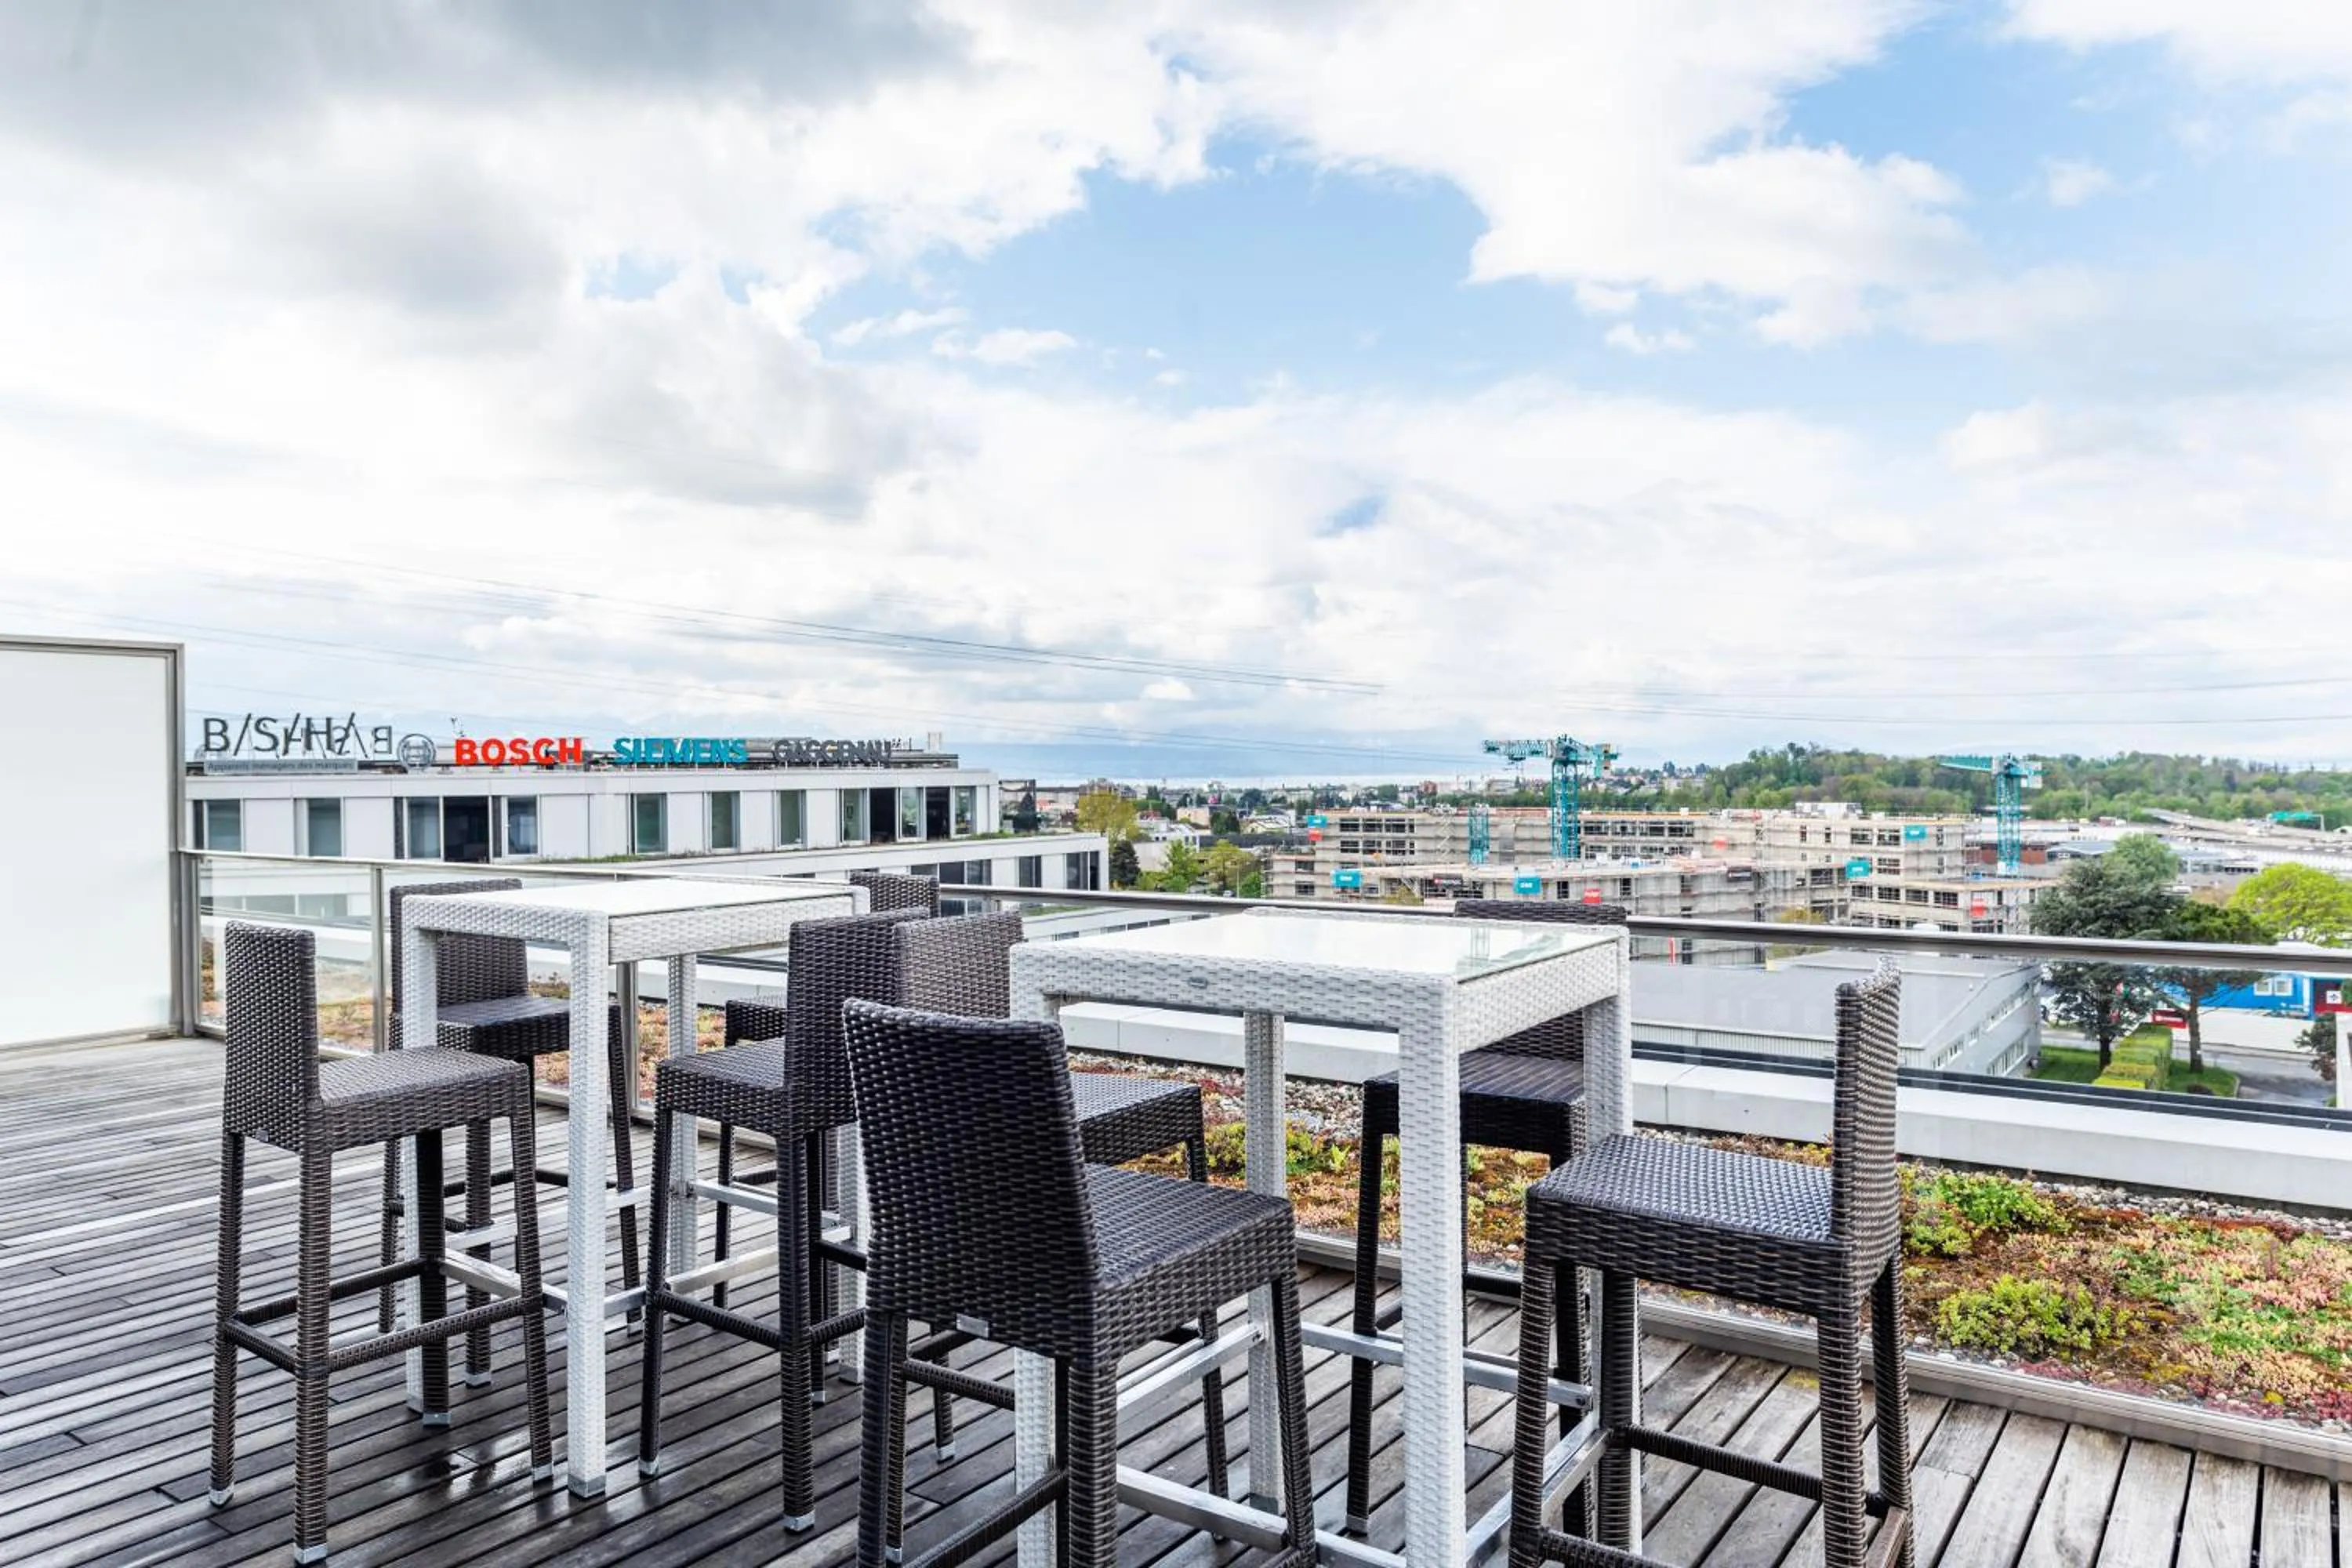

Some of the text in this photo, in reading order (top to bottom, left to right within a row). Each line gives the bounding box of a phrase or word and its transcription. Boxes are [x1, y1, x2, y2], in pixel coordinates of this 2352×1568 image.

[455, 738, 583, 765] BOSCH
[613, 737, 748, 764] SIEMENS
[774, 739, 891, 763] GAGGENAU
